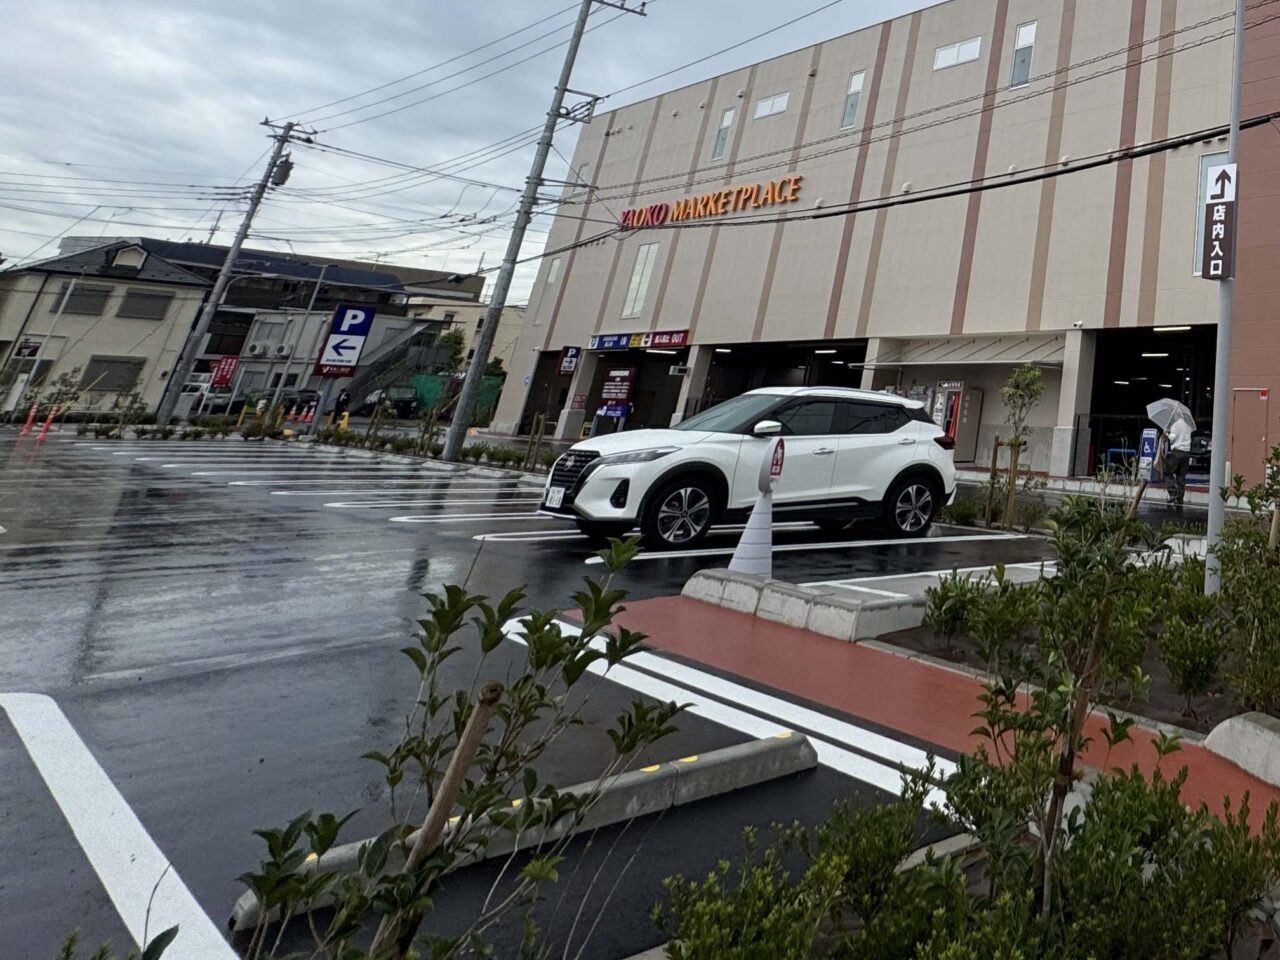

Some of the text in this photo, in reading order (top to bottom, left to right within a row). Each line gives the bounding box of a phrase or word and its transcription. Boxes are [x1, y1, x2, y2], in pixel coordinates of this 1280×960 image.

[619, 175, 804, 230] YAOKO MARKETPLACE
[1210, 205, 1226, 276] 店内入口
[340, 309, 366, 331] P
[567, 348, 577, 358] P
